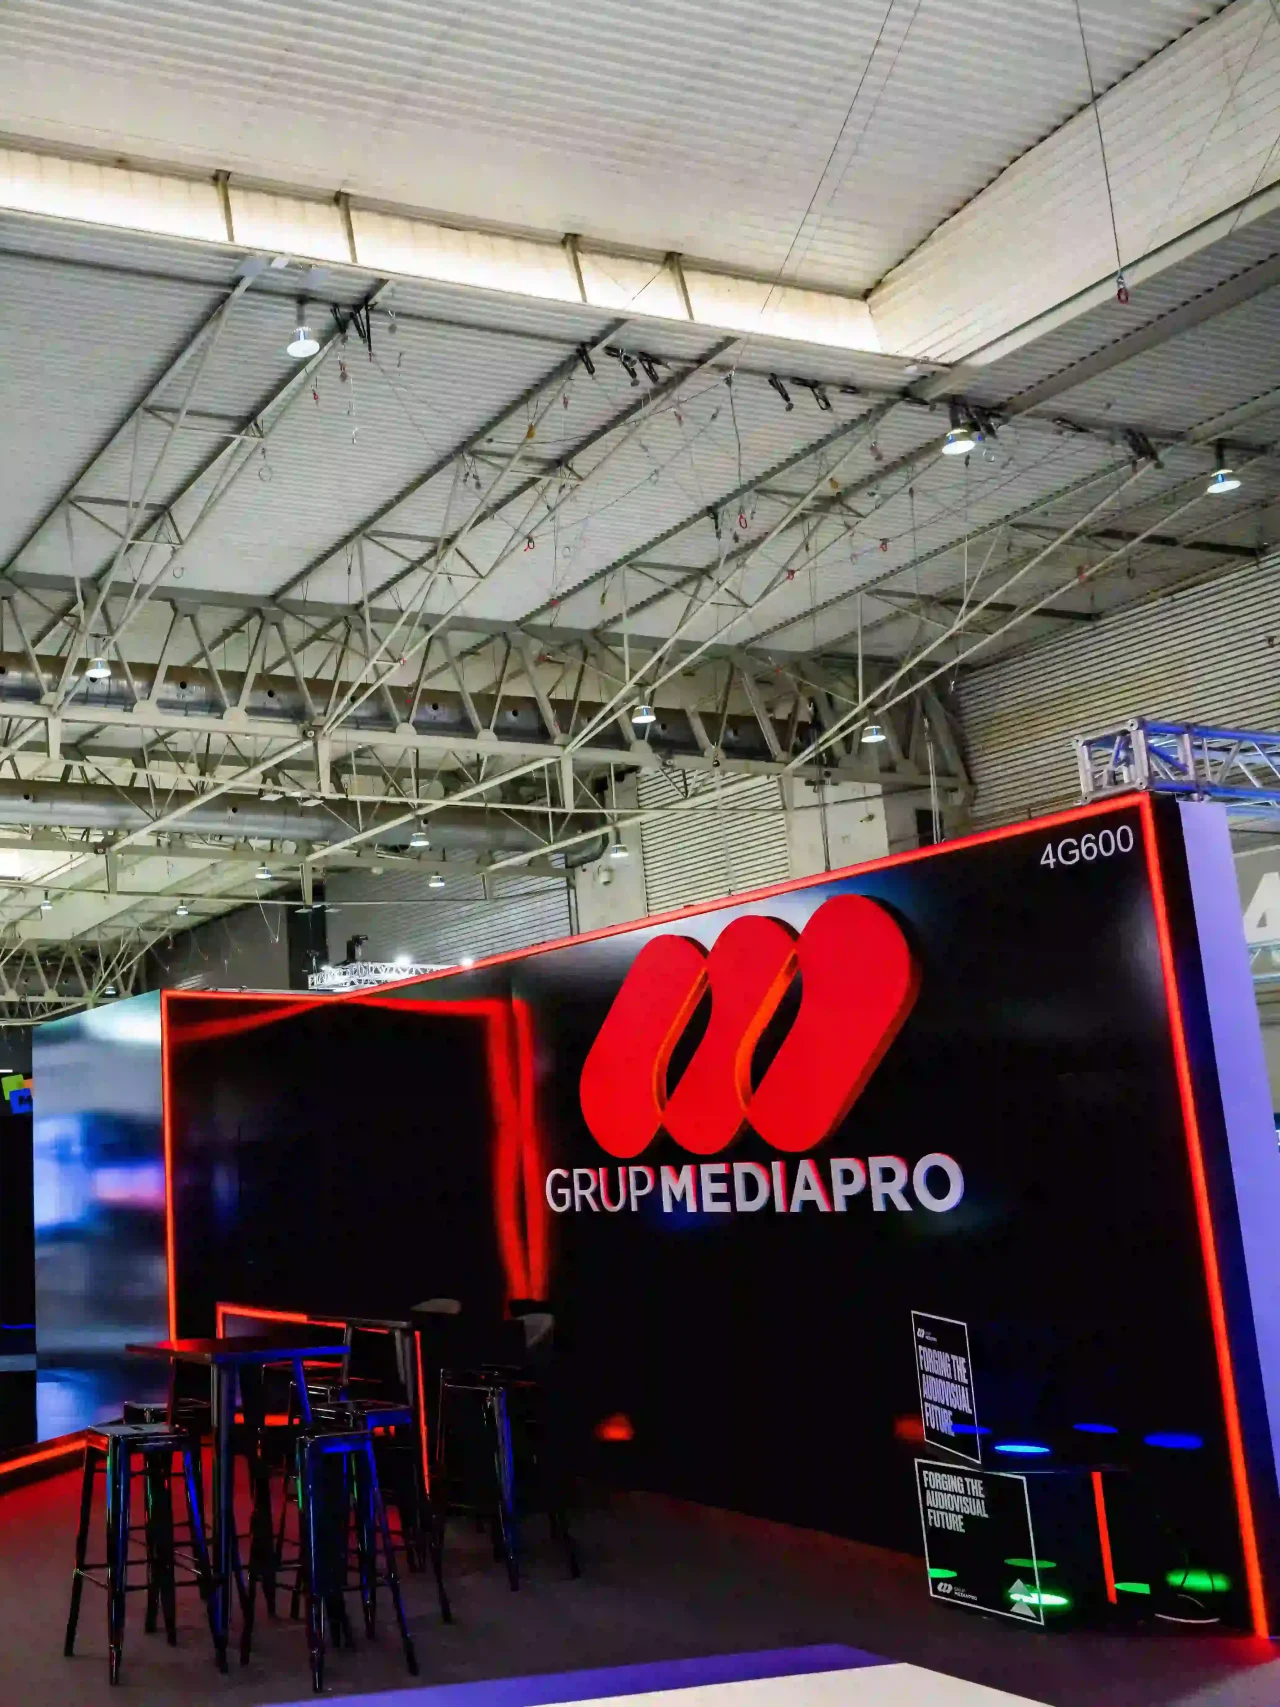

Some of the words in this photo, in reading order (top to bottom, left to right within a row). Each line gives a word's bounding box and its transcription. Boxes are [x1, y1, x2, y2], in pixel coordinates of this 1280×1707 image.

[1040, 825, 1133, 869] 4G600
[918, 1345, 952, 1380] FORGING
[951, 1354, 969, 1384] THE
[922, 1373, 972, 1415] AUDIOVISUAL
[924, 1401, 955, 1437] FUTURE
[923, 1470, 965, 1494] FORGING
[965, 1477, 985, 1499] THE
[926, 1490, 989, 1518] AUDIOVISUAL
[927, 1508, 965, 1533] FUTURE
